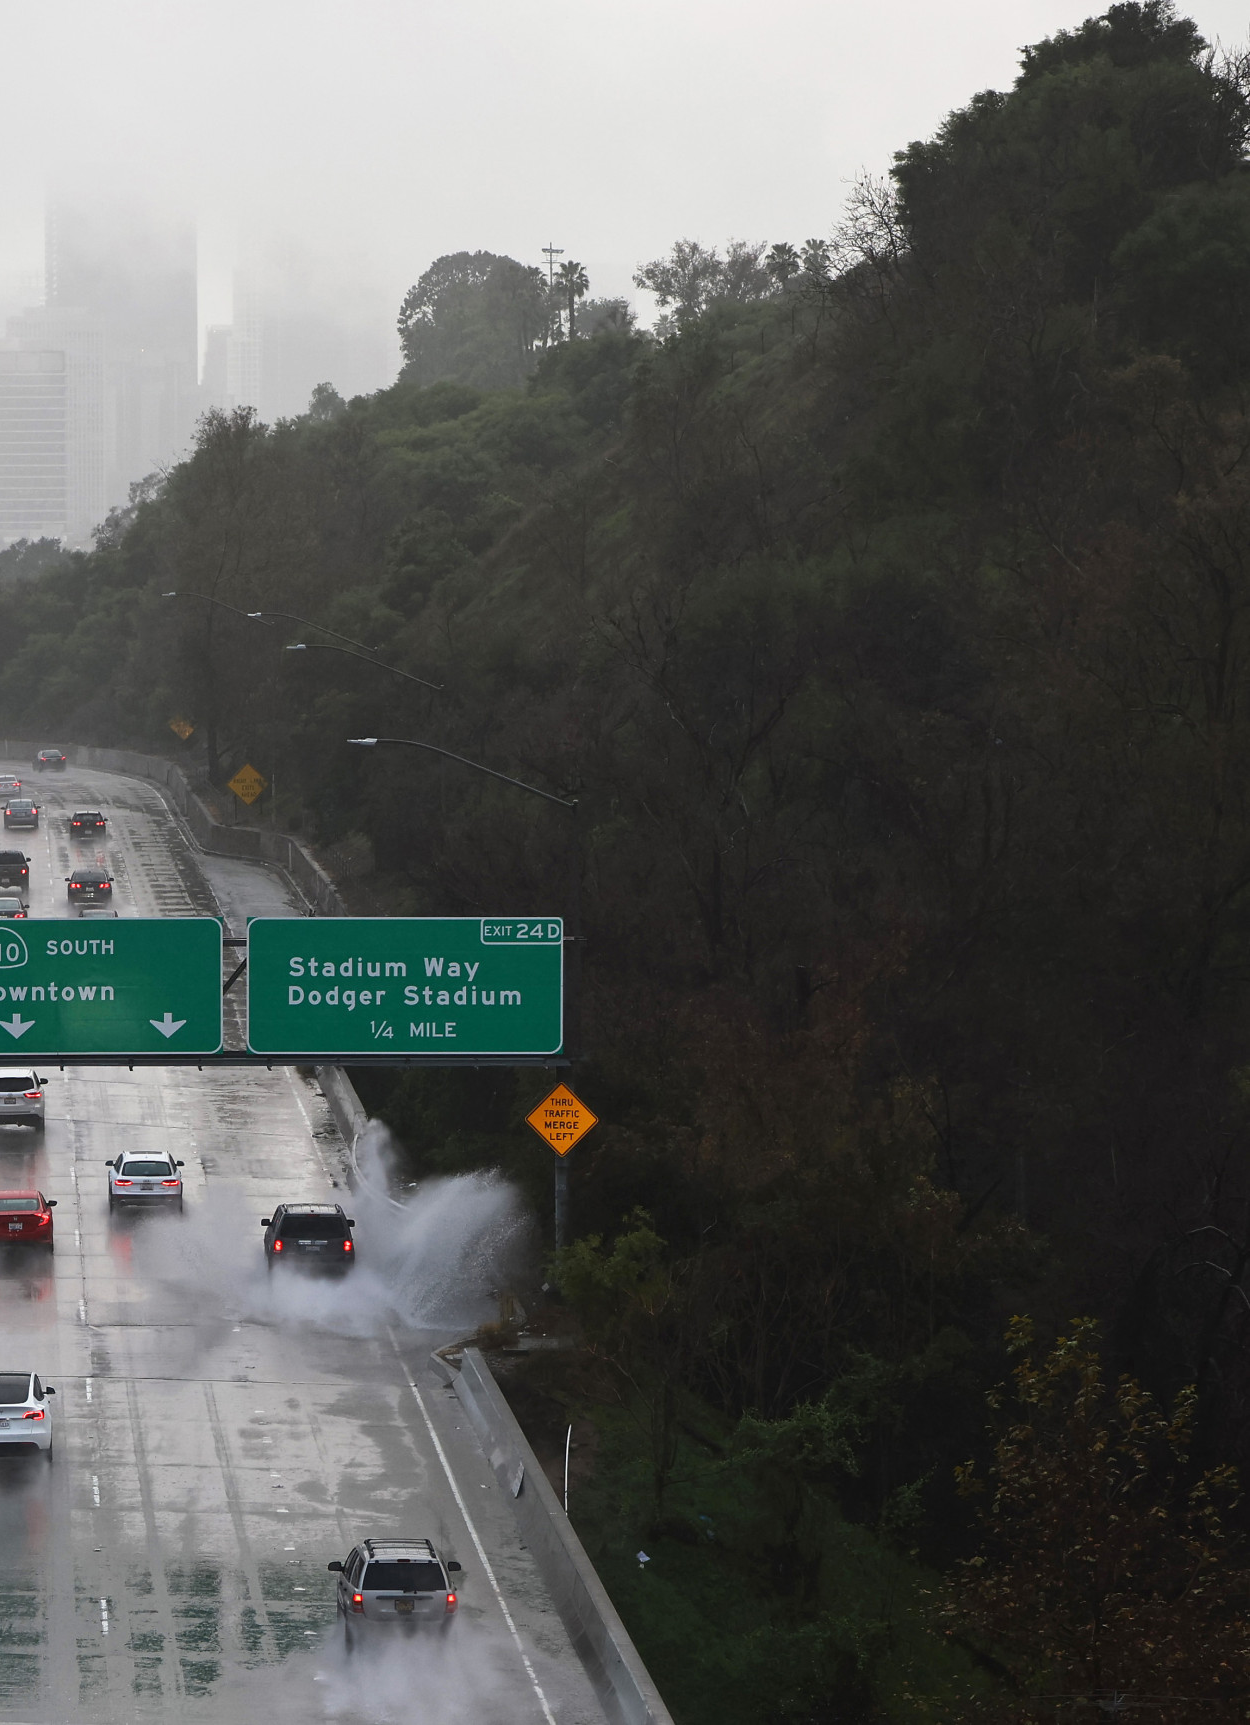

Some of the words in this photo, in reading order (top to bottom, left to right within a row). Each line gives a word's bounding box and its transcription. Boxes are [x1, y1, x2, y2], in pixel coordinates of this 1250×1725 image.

[484, 925, 513, 937] EXIT
[46, 939, 114, 955] SOUTH
[289, 956, 407, 977] Stadium
[423, 957, 480, 982] Way
[288, 985, 386, 1011] Dodger
[403, 985, 522, 1006] Stadium
[409, 1022, 457, 1038] MILE
[551, 1098, 573, 1106] THRU
[544, 1110, 580, 1118] TRAFFIC
[544, 1121, 580, 1130] MERGE
